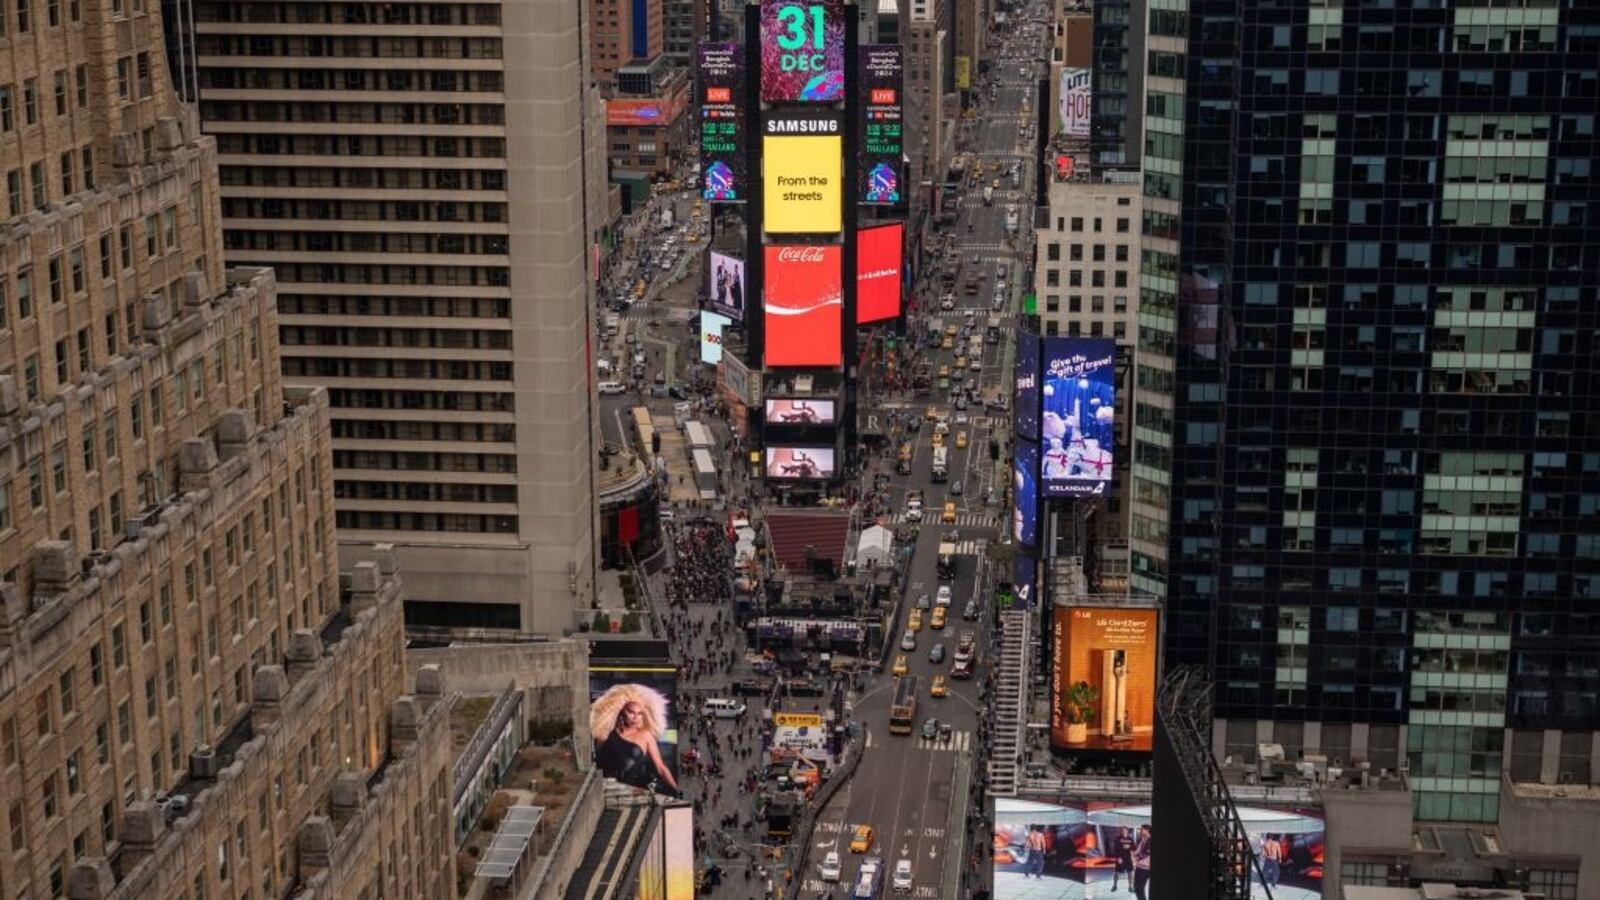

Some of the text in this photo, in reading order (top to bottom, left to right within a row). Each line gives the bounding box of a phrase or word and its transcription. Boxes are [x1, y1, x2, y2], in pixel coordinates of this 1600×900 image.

[777, 5, 825, 50] 31
[780, 54, 825, 71] DEC
[709, 90, 730, 99] LIVE
[874, 92, 894, 101] LIVE
[768, 120, 838, 132] SAMSUNG
[777, 176, 828, 186] From the
[782, 192, 823, 201] streets
[1051, 354, 1087, 369] Give the
[1085, 355, 1112, 369] travel
[868, 416, 879, 429] R
